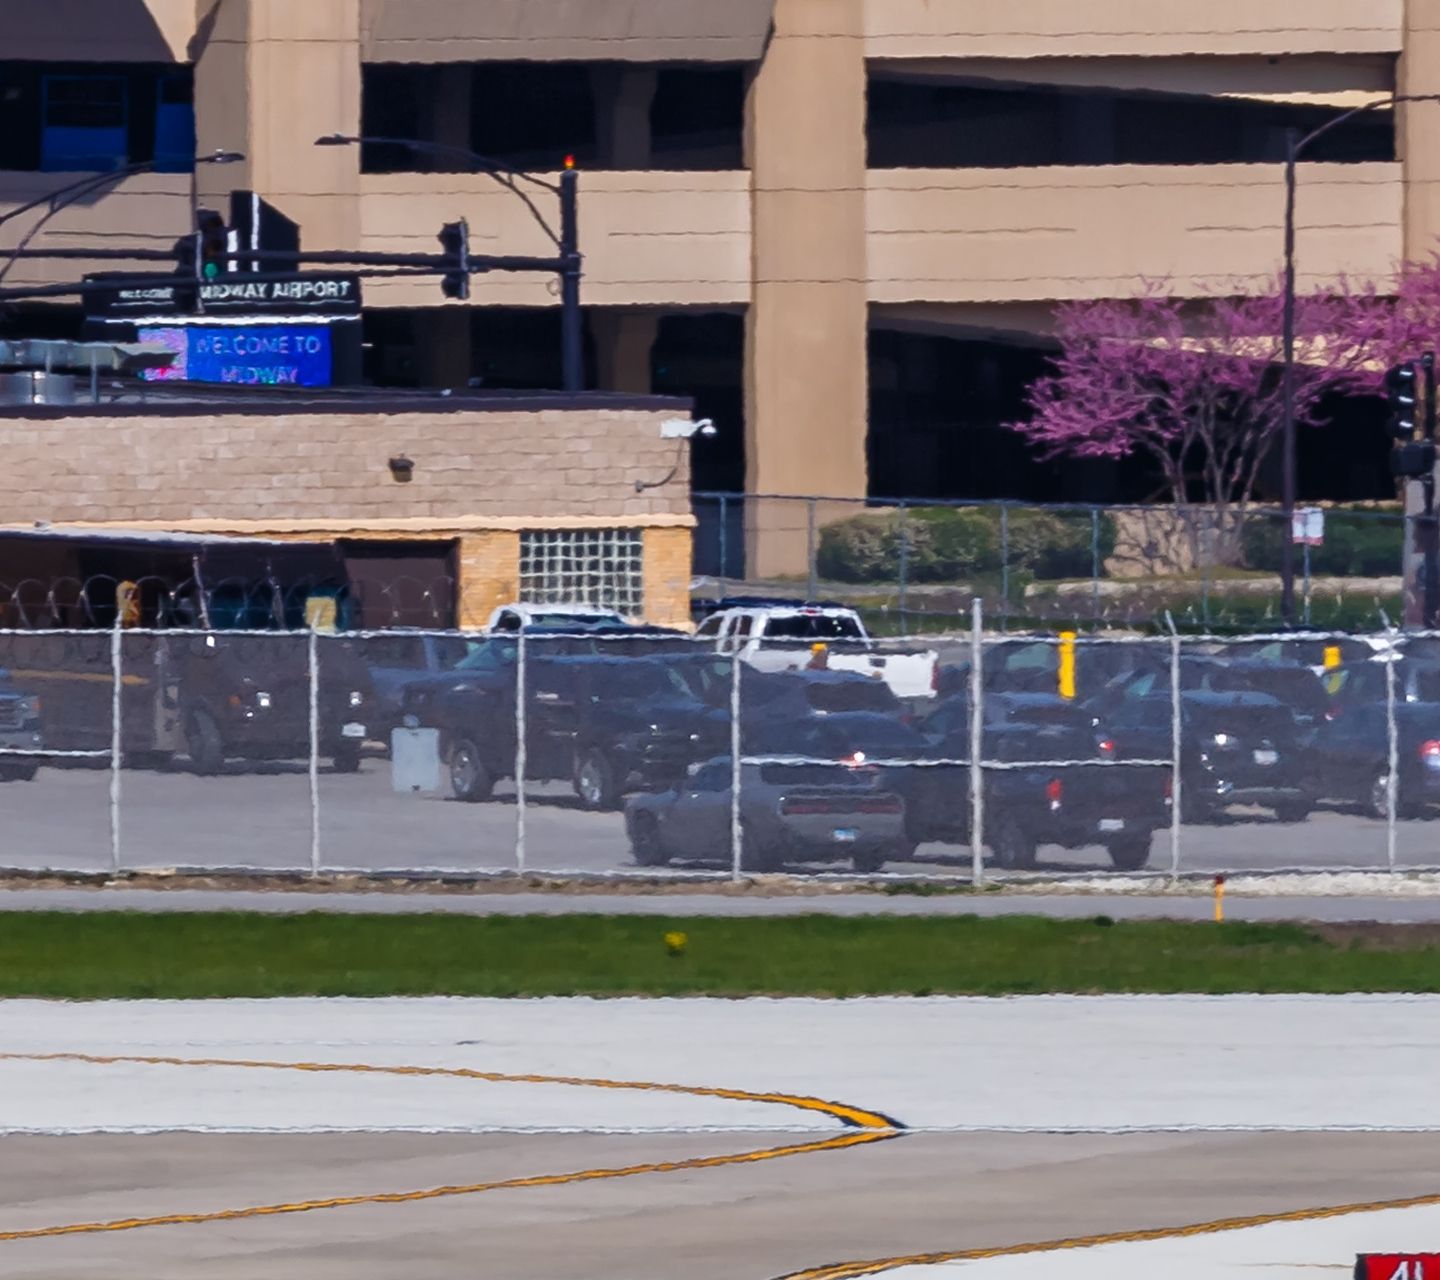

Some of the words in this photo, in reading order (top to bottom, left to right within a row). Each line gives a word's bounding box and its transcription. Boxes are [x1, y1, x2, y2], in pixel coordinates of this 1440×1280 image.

[272, 281, 351, 298] AIRPORT
[196, 335, 289, 355] WELCOME
[294, 336, 321, 354] TO
